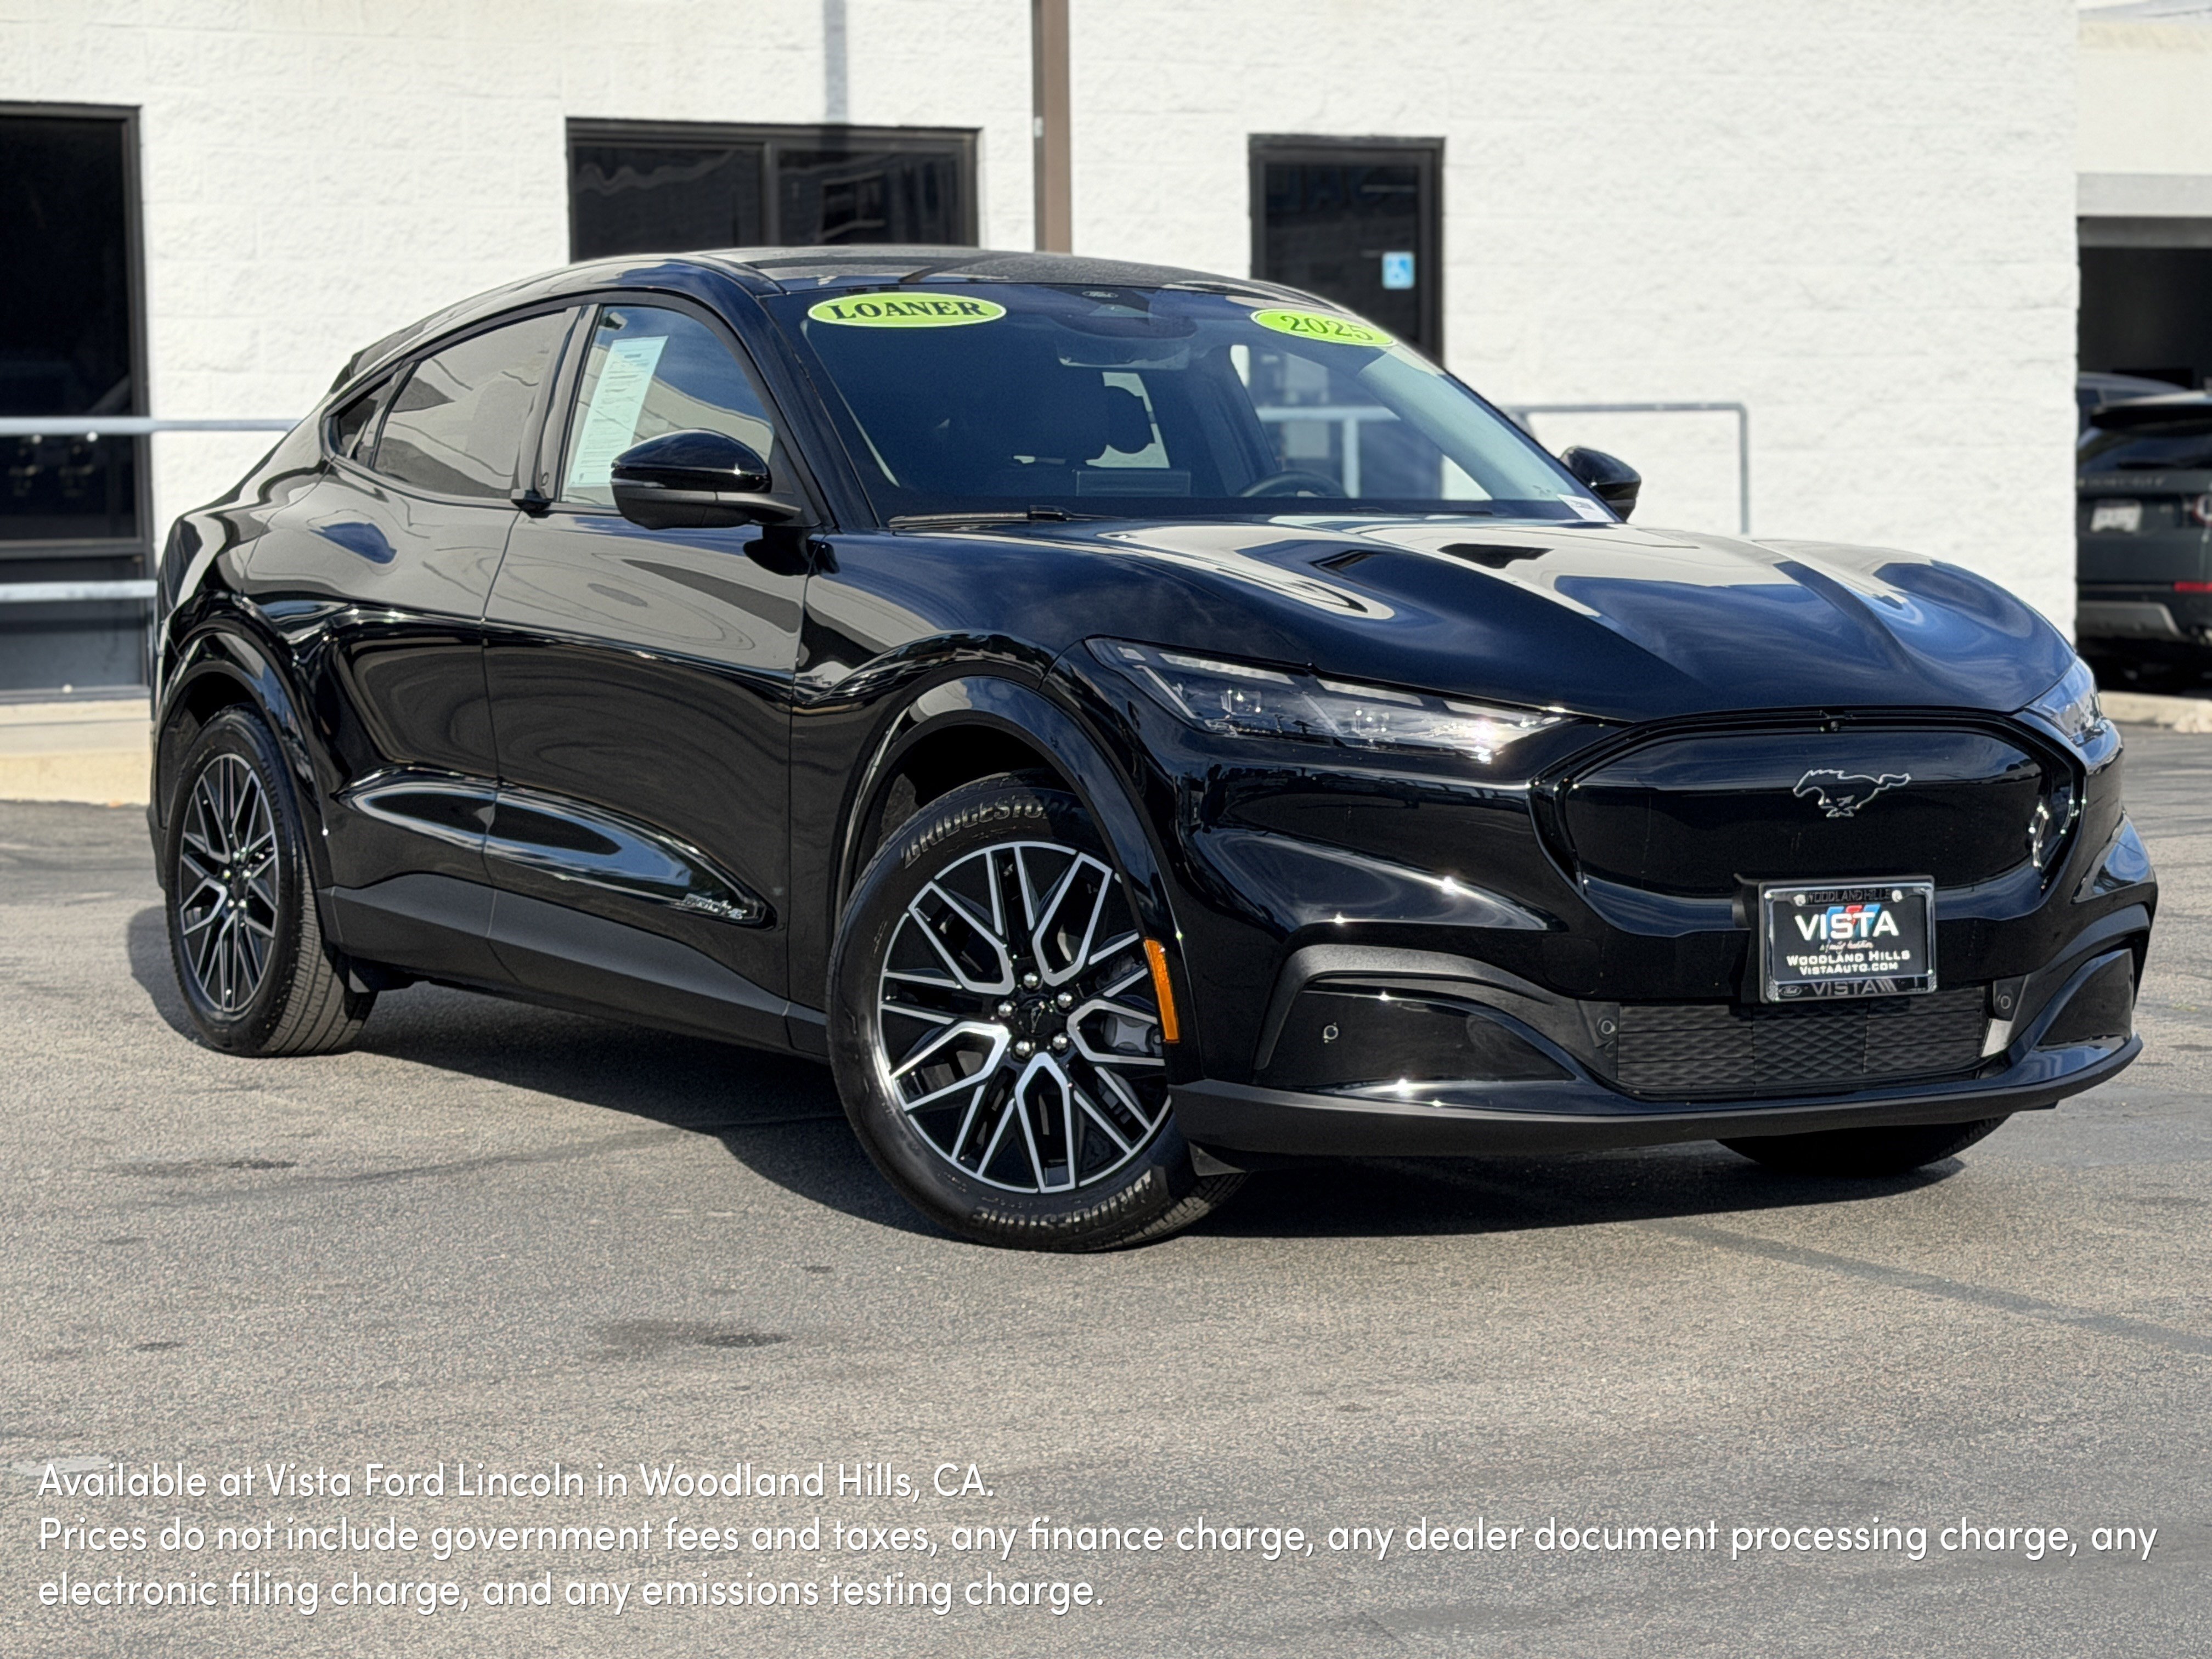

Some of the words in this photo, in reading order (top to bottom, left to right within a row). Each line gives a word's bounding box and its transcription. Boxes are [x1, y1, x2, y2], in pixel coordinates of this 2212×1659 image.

[826, 301, 988, 320] LOANER
[1279, 315, 1373, 341] 2025
[1794, 910, 1900, 941] VISTA
[1786, 952, 1864, 967] WOODLAND
[1869, 950, 1911, 961] HILLS
[1811, 979, 1878, 996] VISTA
